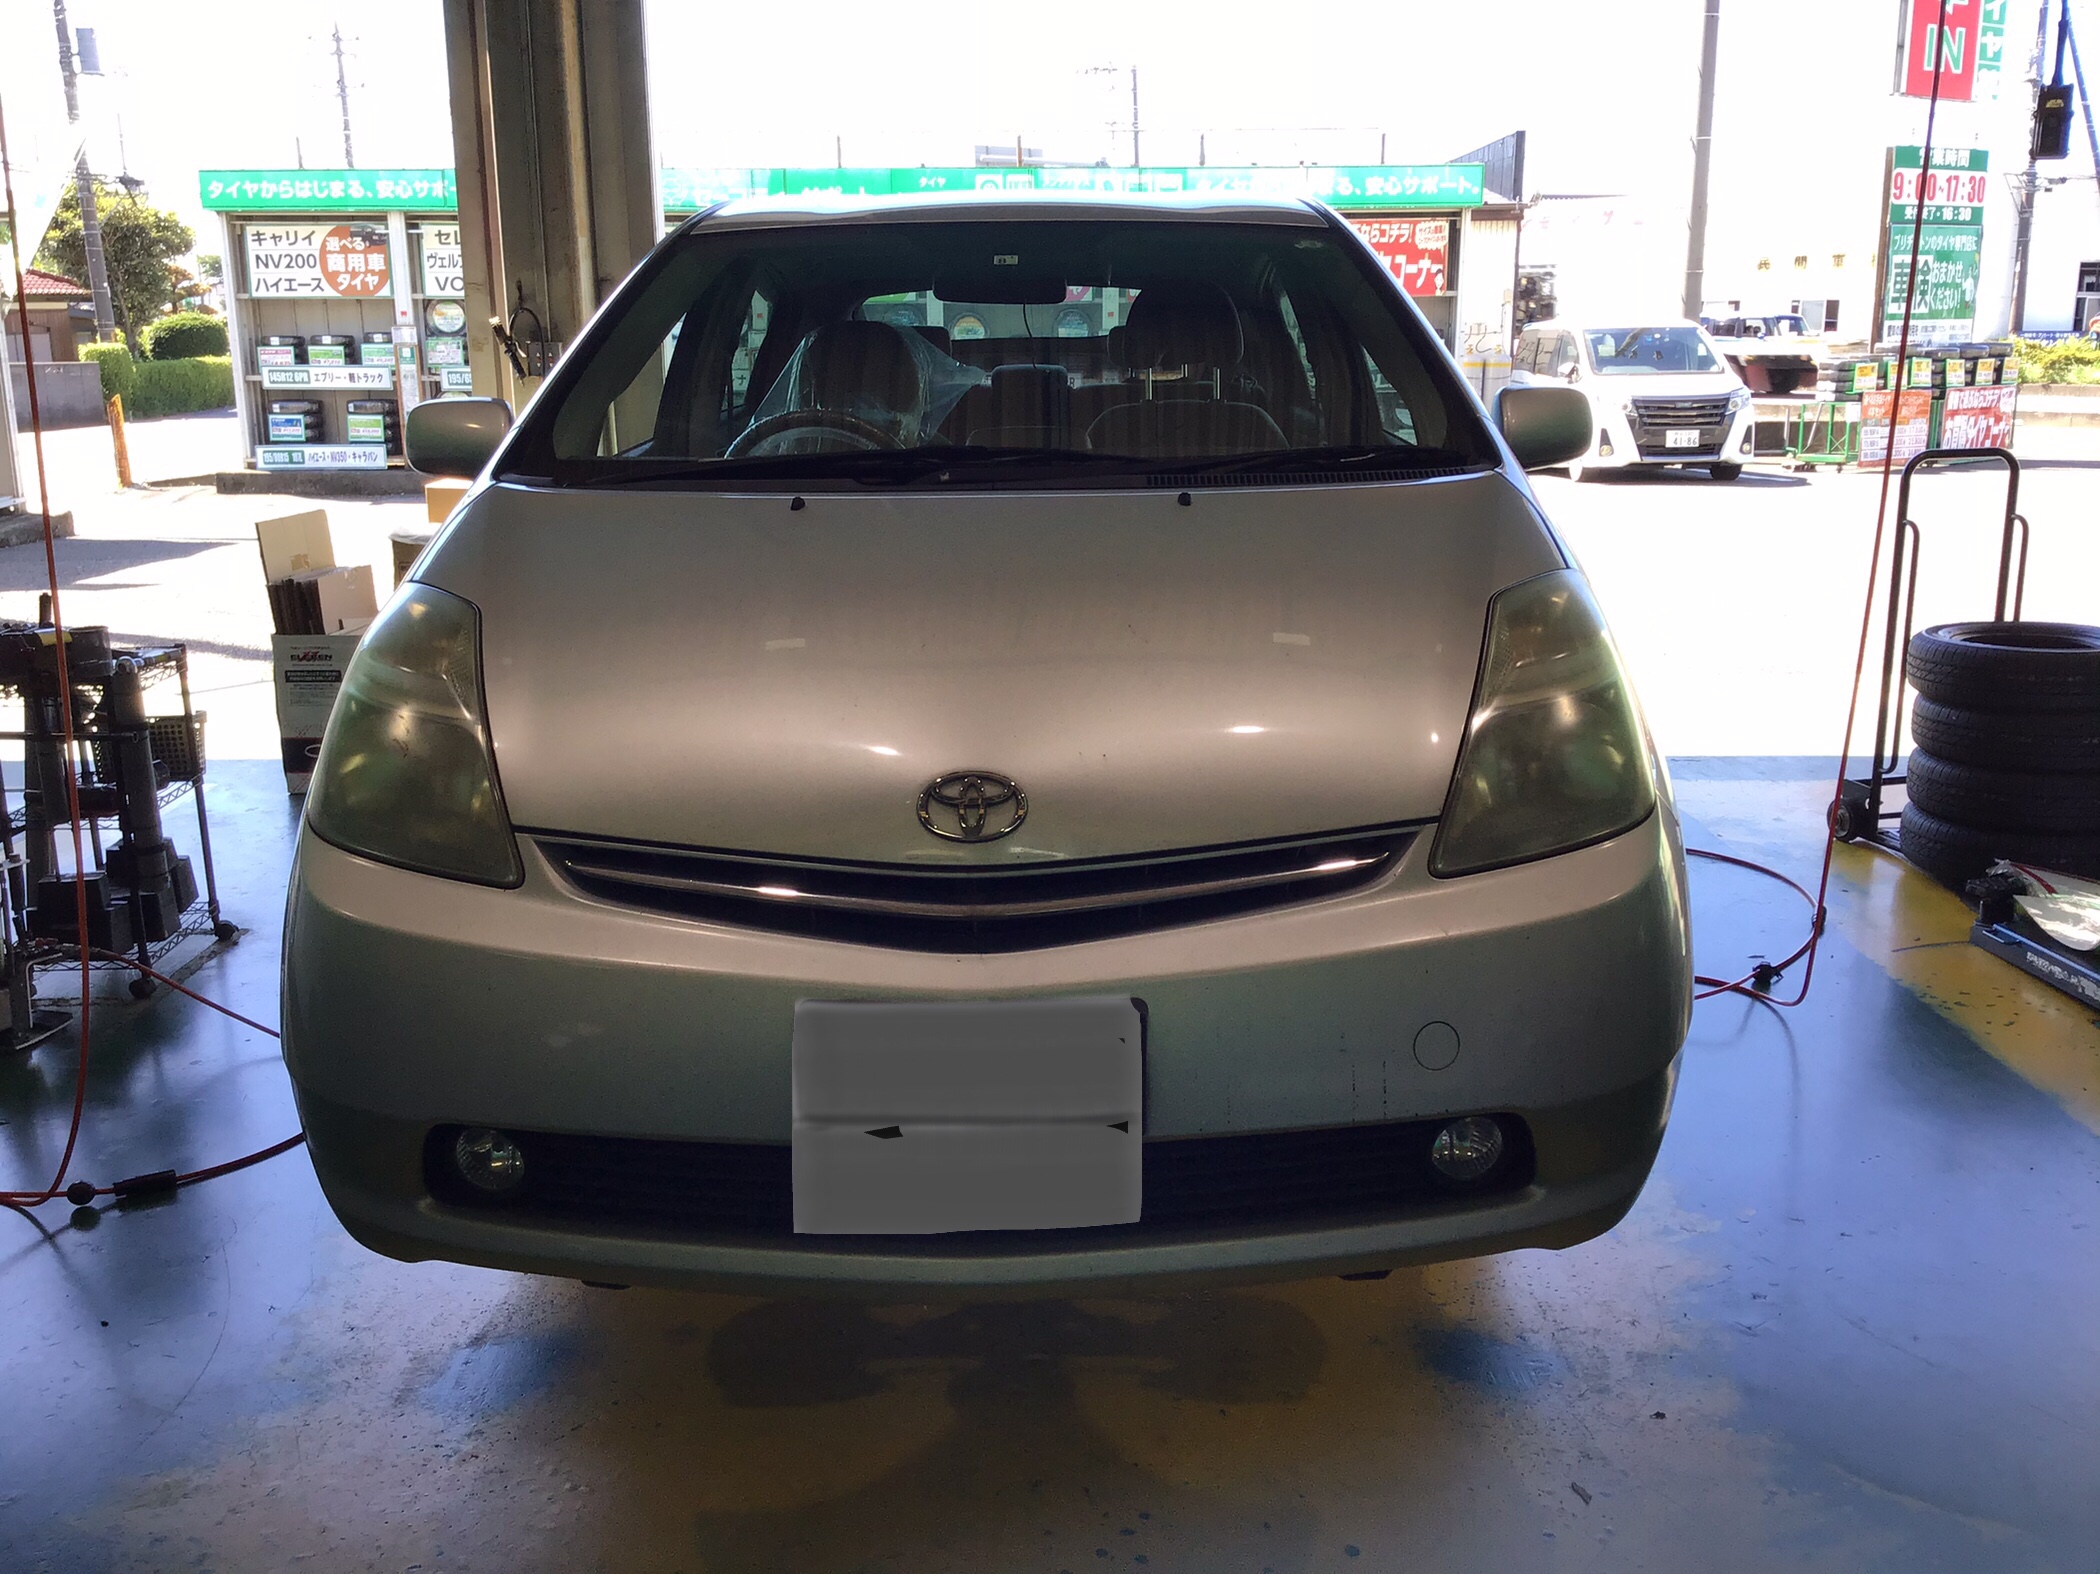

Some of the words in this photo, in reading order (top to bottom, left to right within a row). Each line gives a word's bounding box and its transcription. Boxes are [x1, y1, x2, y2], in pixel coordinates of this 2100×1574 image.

[1924, 23, 1966, 74] IN
[251, 230, 317, 247] キャリイ
[325, 235, 366, 252] 選べる
[255, 253, 317, 269] NV200
[326, 252, 386, 272] 商用車
[255, 277, 325, 293] ハイエース
[336, 273, 380, 291] タイヤ
[1891, 259, 1931, 311] 車検
